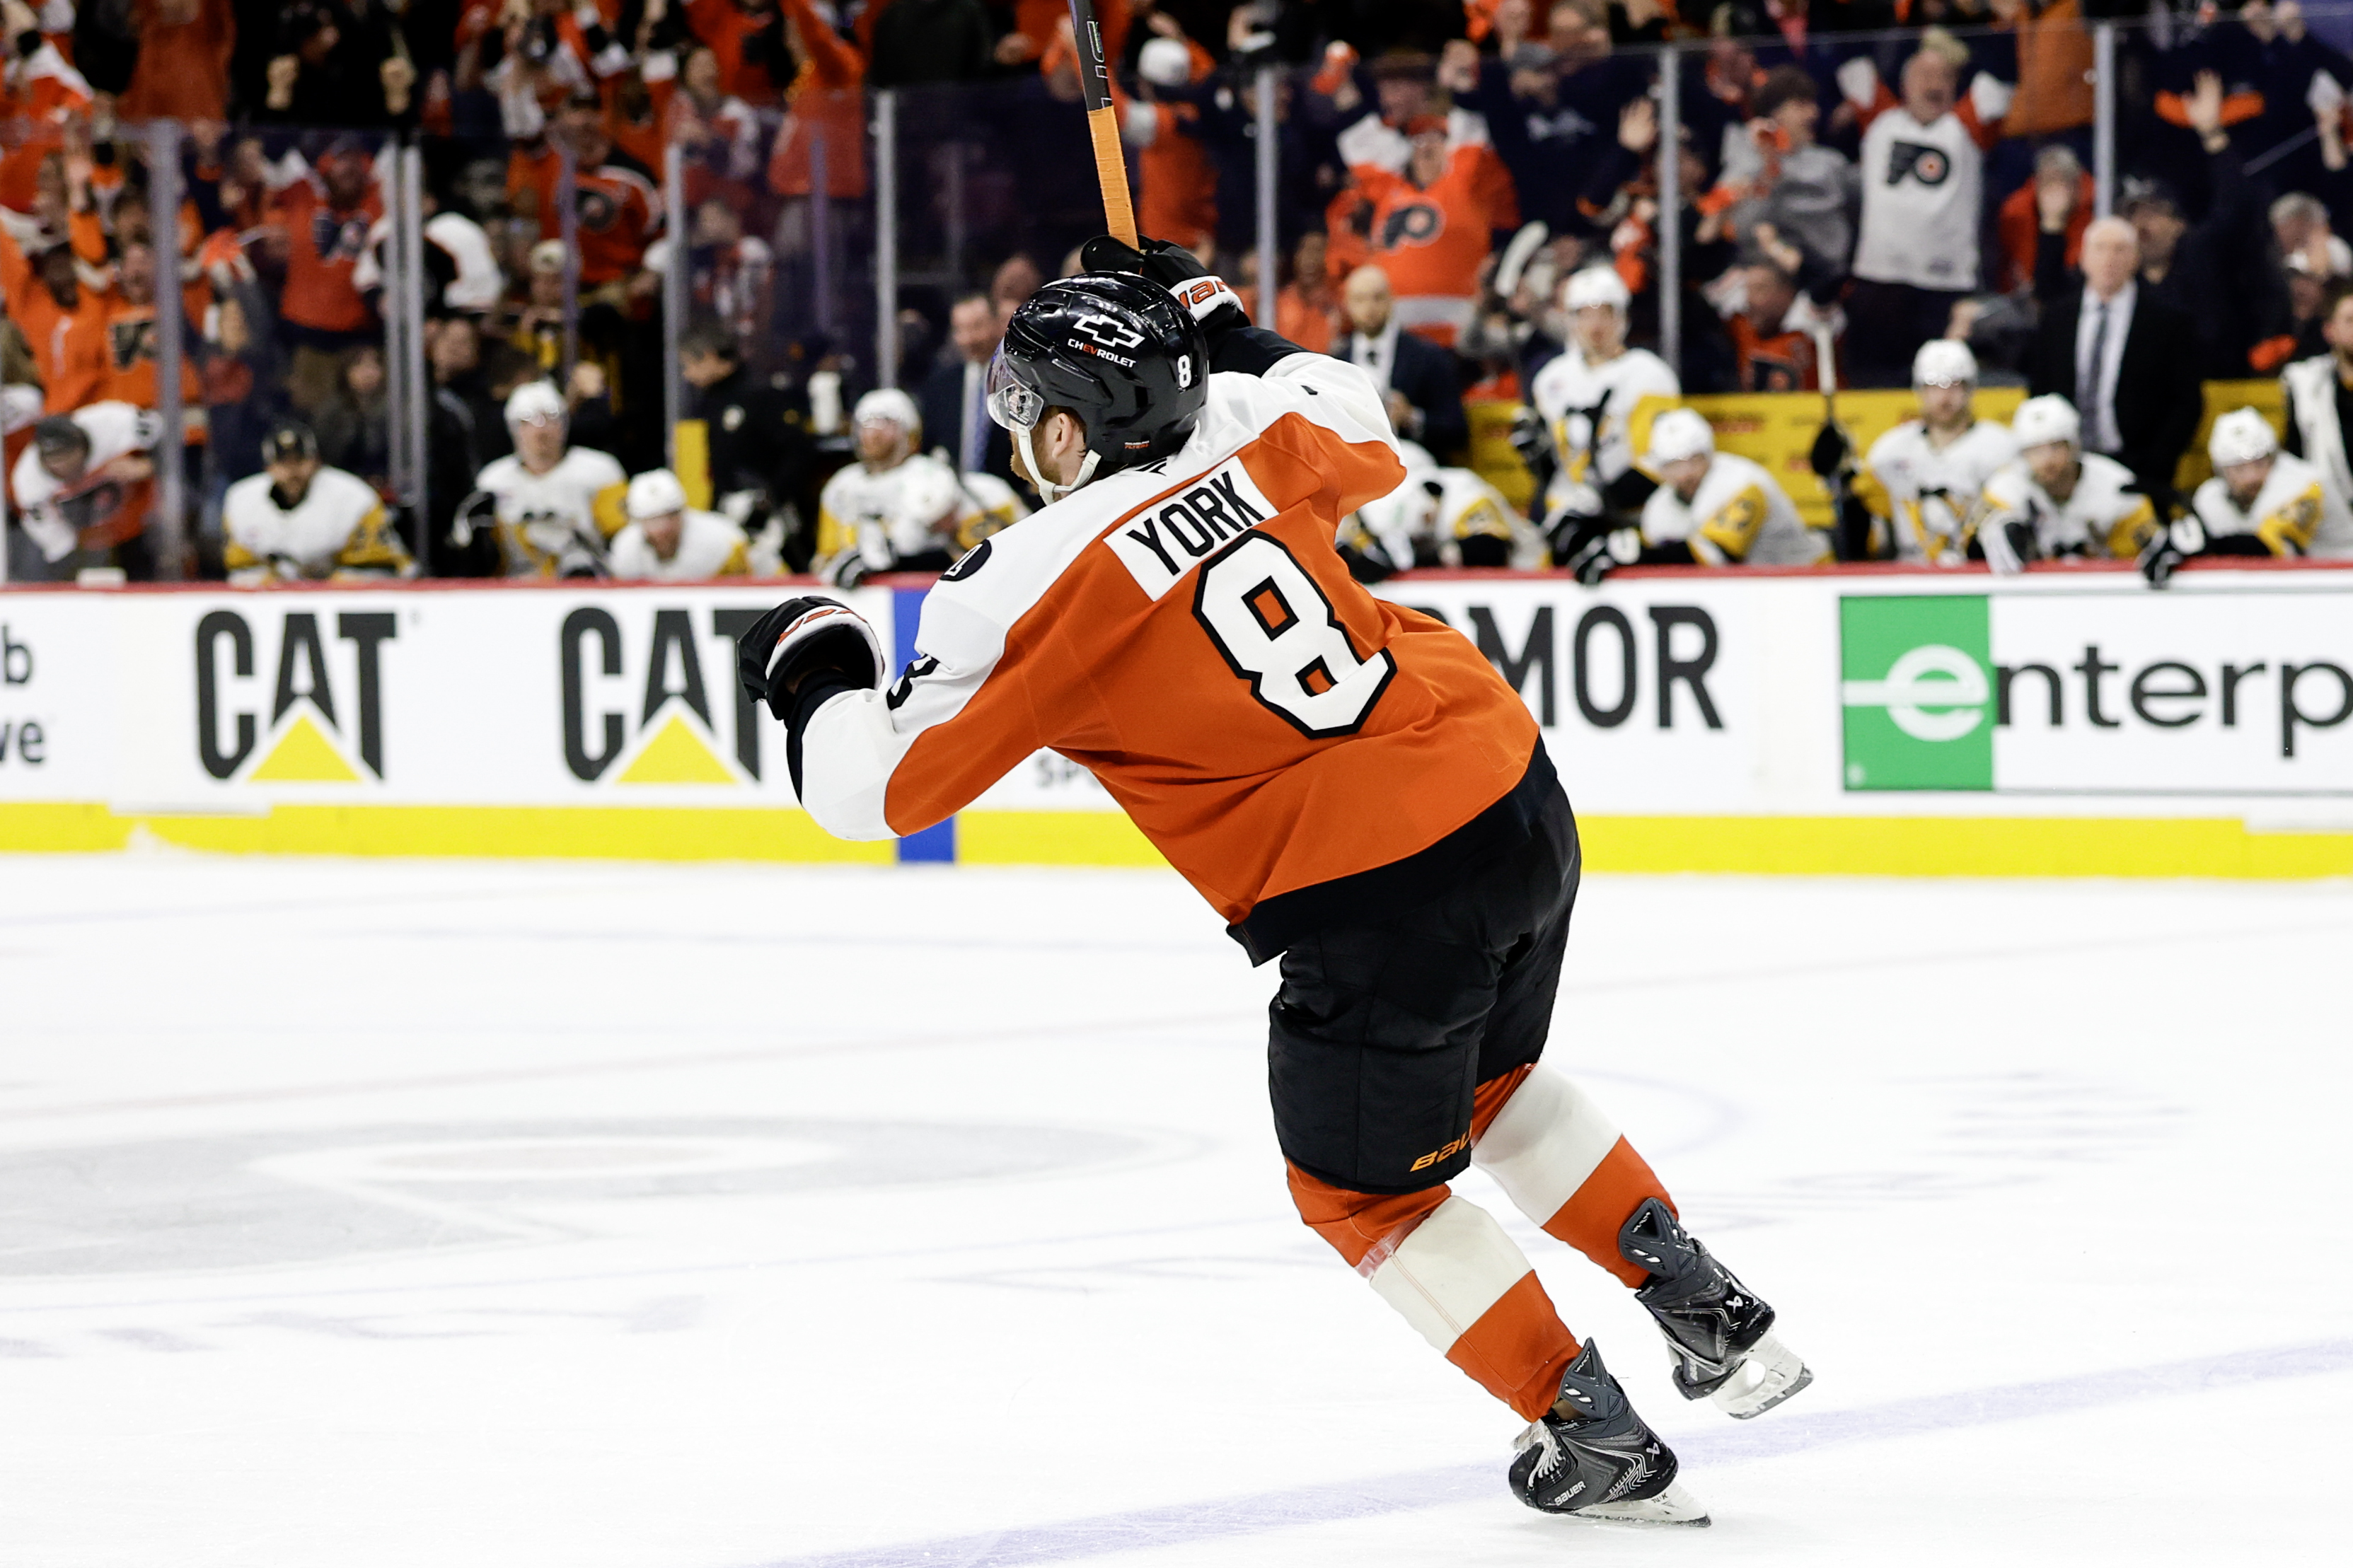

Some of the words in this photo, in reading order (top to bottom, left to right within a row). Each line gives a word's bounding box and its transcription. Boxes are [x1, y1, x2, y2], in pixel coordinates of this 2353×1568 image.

[1068, 338, 1136, 368] CHEVROLET
[1177, 354, 1192, 388] 8
[1126, 470, 1266, 576] YORK
[1192, 529, 1398, 741] 8
[1410, 605, 1723, 728] MOR
[196, 610, 397, 783] CAT
[561, 607, 775, 782] CAT
[1843, 644, 2353, 758] enterp
